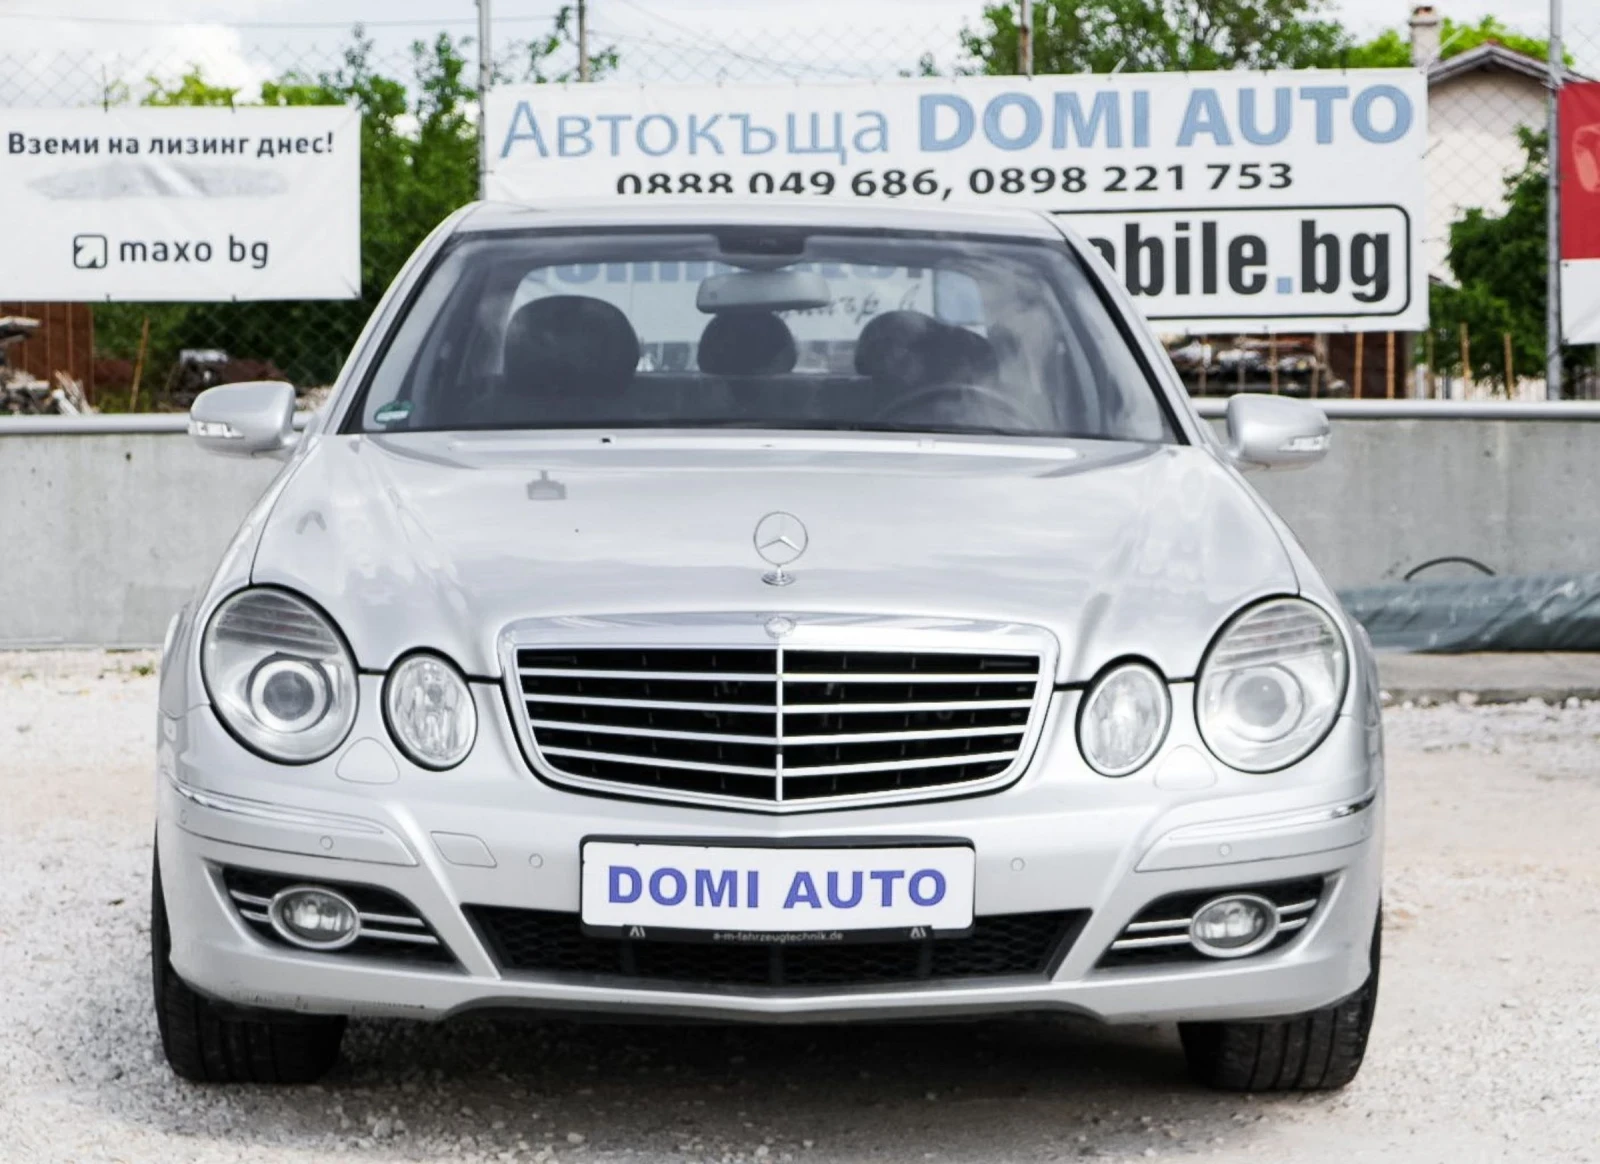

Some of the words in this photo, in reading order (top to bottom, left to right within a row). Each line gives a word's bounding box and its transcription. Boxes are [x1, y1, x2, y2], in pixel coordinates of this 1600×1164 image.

[500, 101, 888, 165] Автокъща
[919, 90, 1150, 152] DOMI
[1176, 84, 1413, 147] AUTO
[8, 132, 99, 155] Вземи
[108, 137, 139, 154] на
[149, 136, 249, 154] лизинг
[256, 131, 334, 157] днес!
[617, 172, 733, 194] 0888
[749, 171, 835, 195] 049
[851, 169, 953, 201] 686,
[969, 166, 1087, 194] 0898
[1104, 165, 1184, 191] 221
[1207, 162, 1293, 189] 753
[120, 241, 212, 263] maxo
[229, 234, 269, 269] bg
[608, 865, 760, 908] DOMI
[783, 868, 947, 909] AUTO
[713, 930, 843, 943] a-m-fahrzeugtechnik.de
